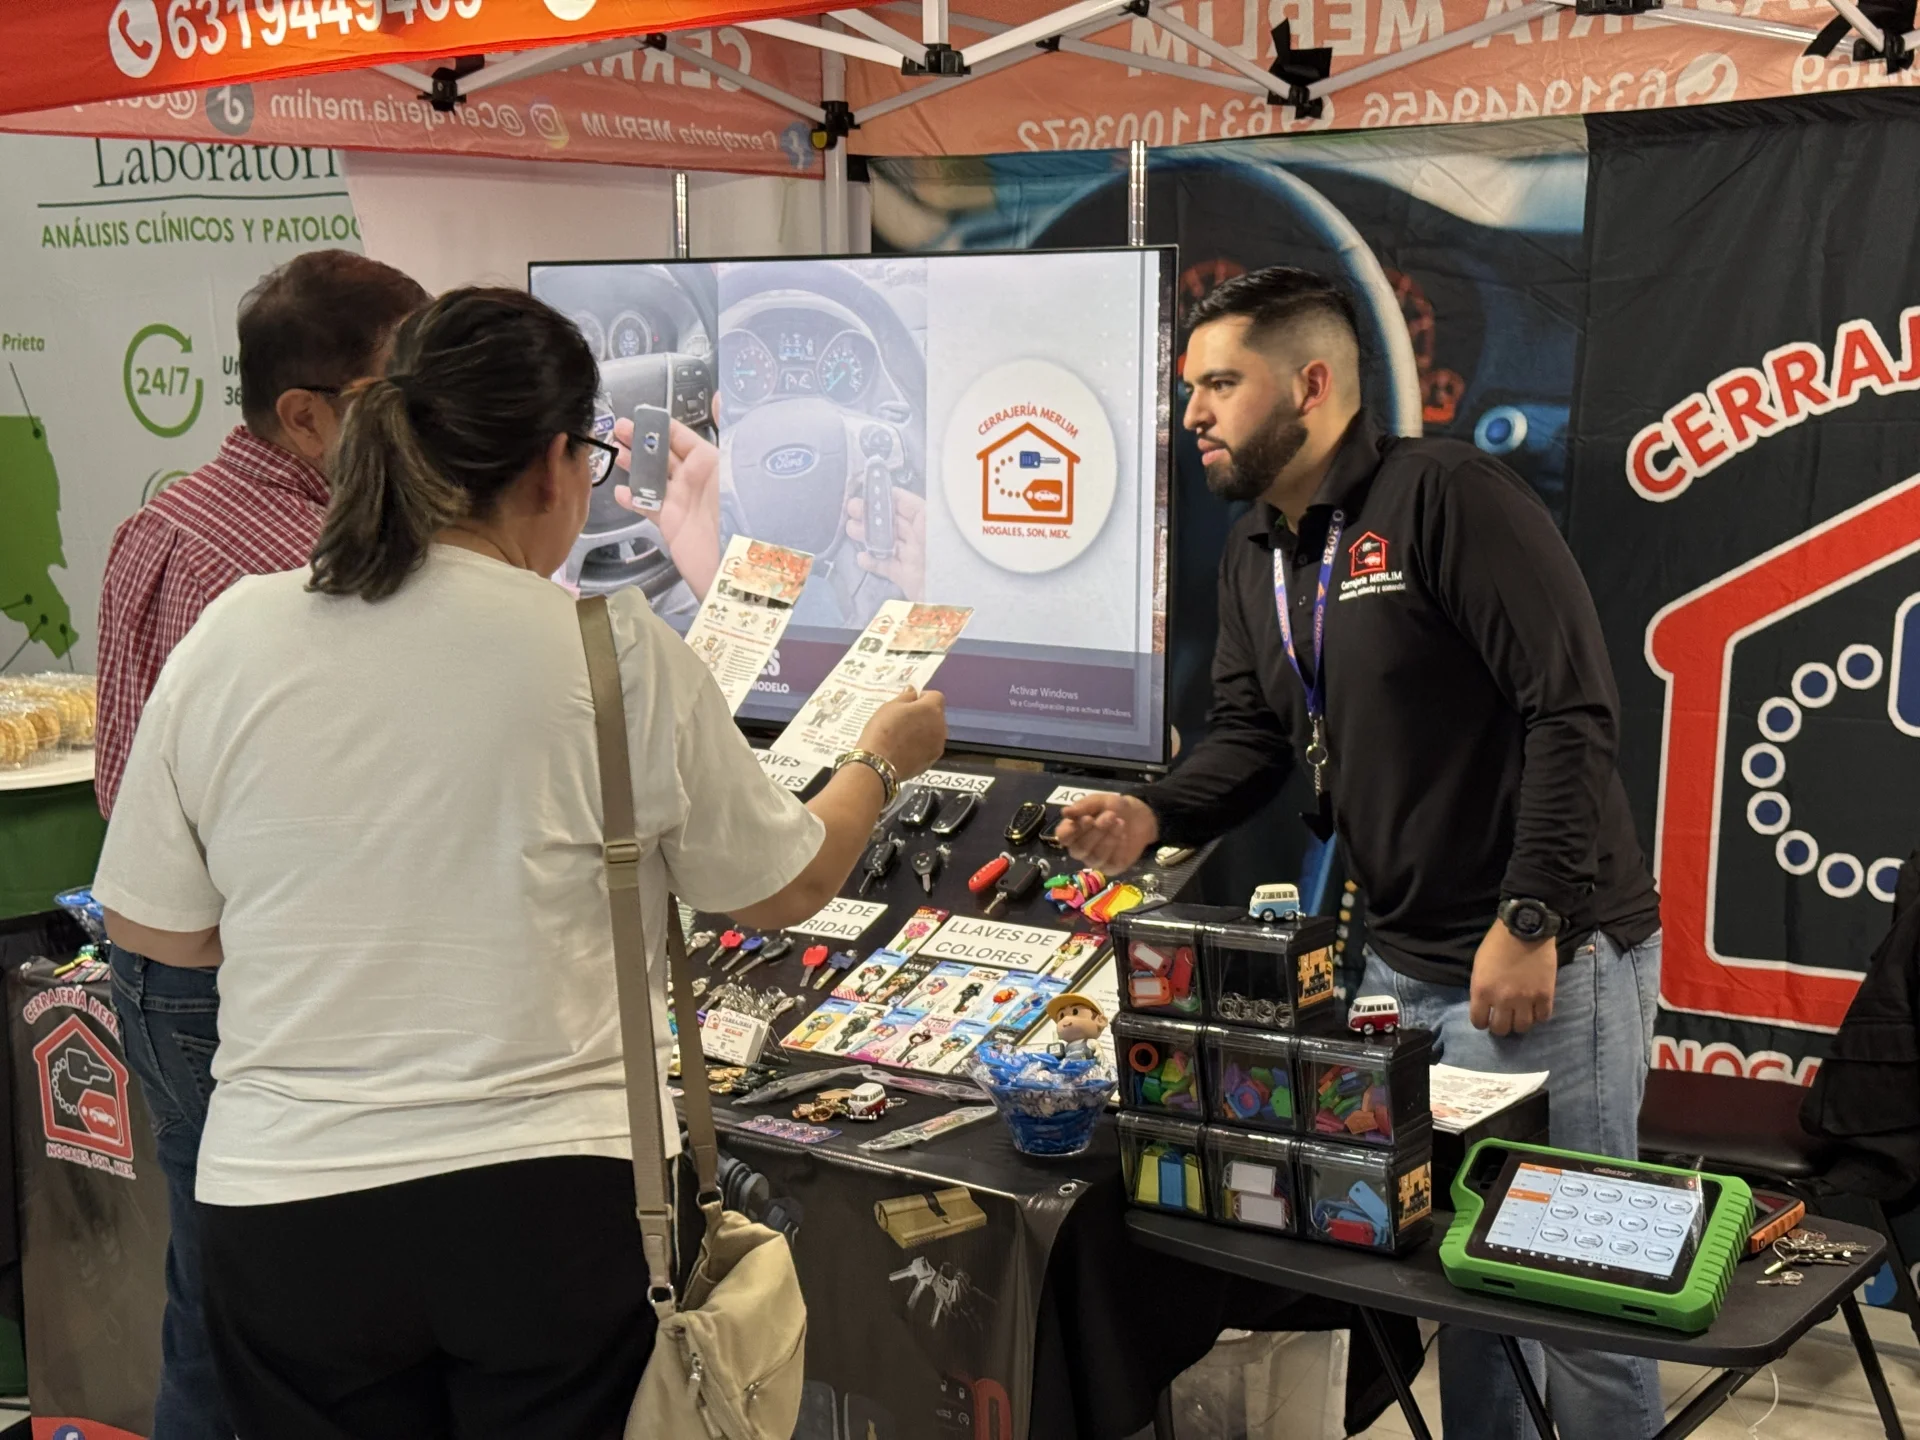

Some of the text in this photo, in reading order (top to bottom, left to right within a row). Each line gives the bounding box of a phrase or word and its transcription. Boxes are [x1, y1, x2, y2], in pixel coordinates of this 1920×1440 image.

[41, 212, 130, 249] ANÁLISIS
[135, 211, 235, 244] CLÍNICOS
[242, 219, 256, 243] Y
[136, 366, 190, 396] 24/7
[977, 401, 1080, 440] CERRAJERÍA MERLIM
[1009, 684, 1079, 701] Activar Windows
[756, 751, 801, 768] AVES
[911, 774, 989, 791] RCASAS
[847, 904, 878, 917] DE
[948, 921, 1024, 942] LLAVES
[1023, 932, 1057, 946] DE
[935, 941, 1033, 965] COLORES
